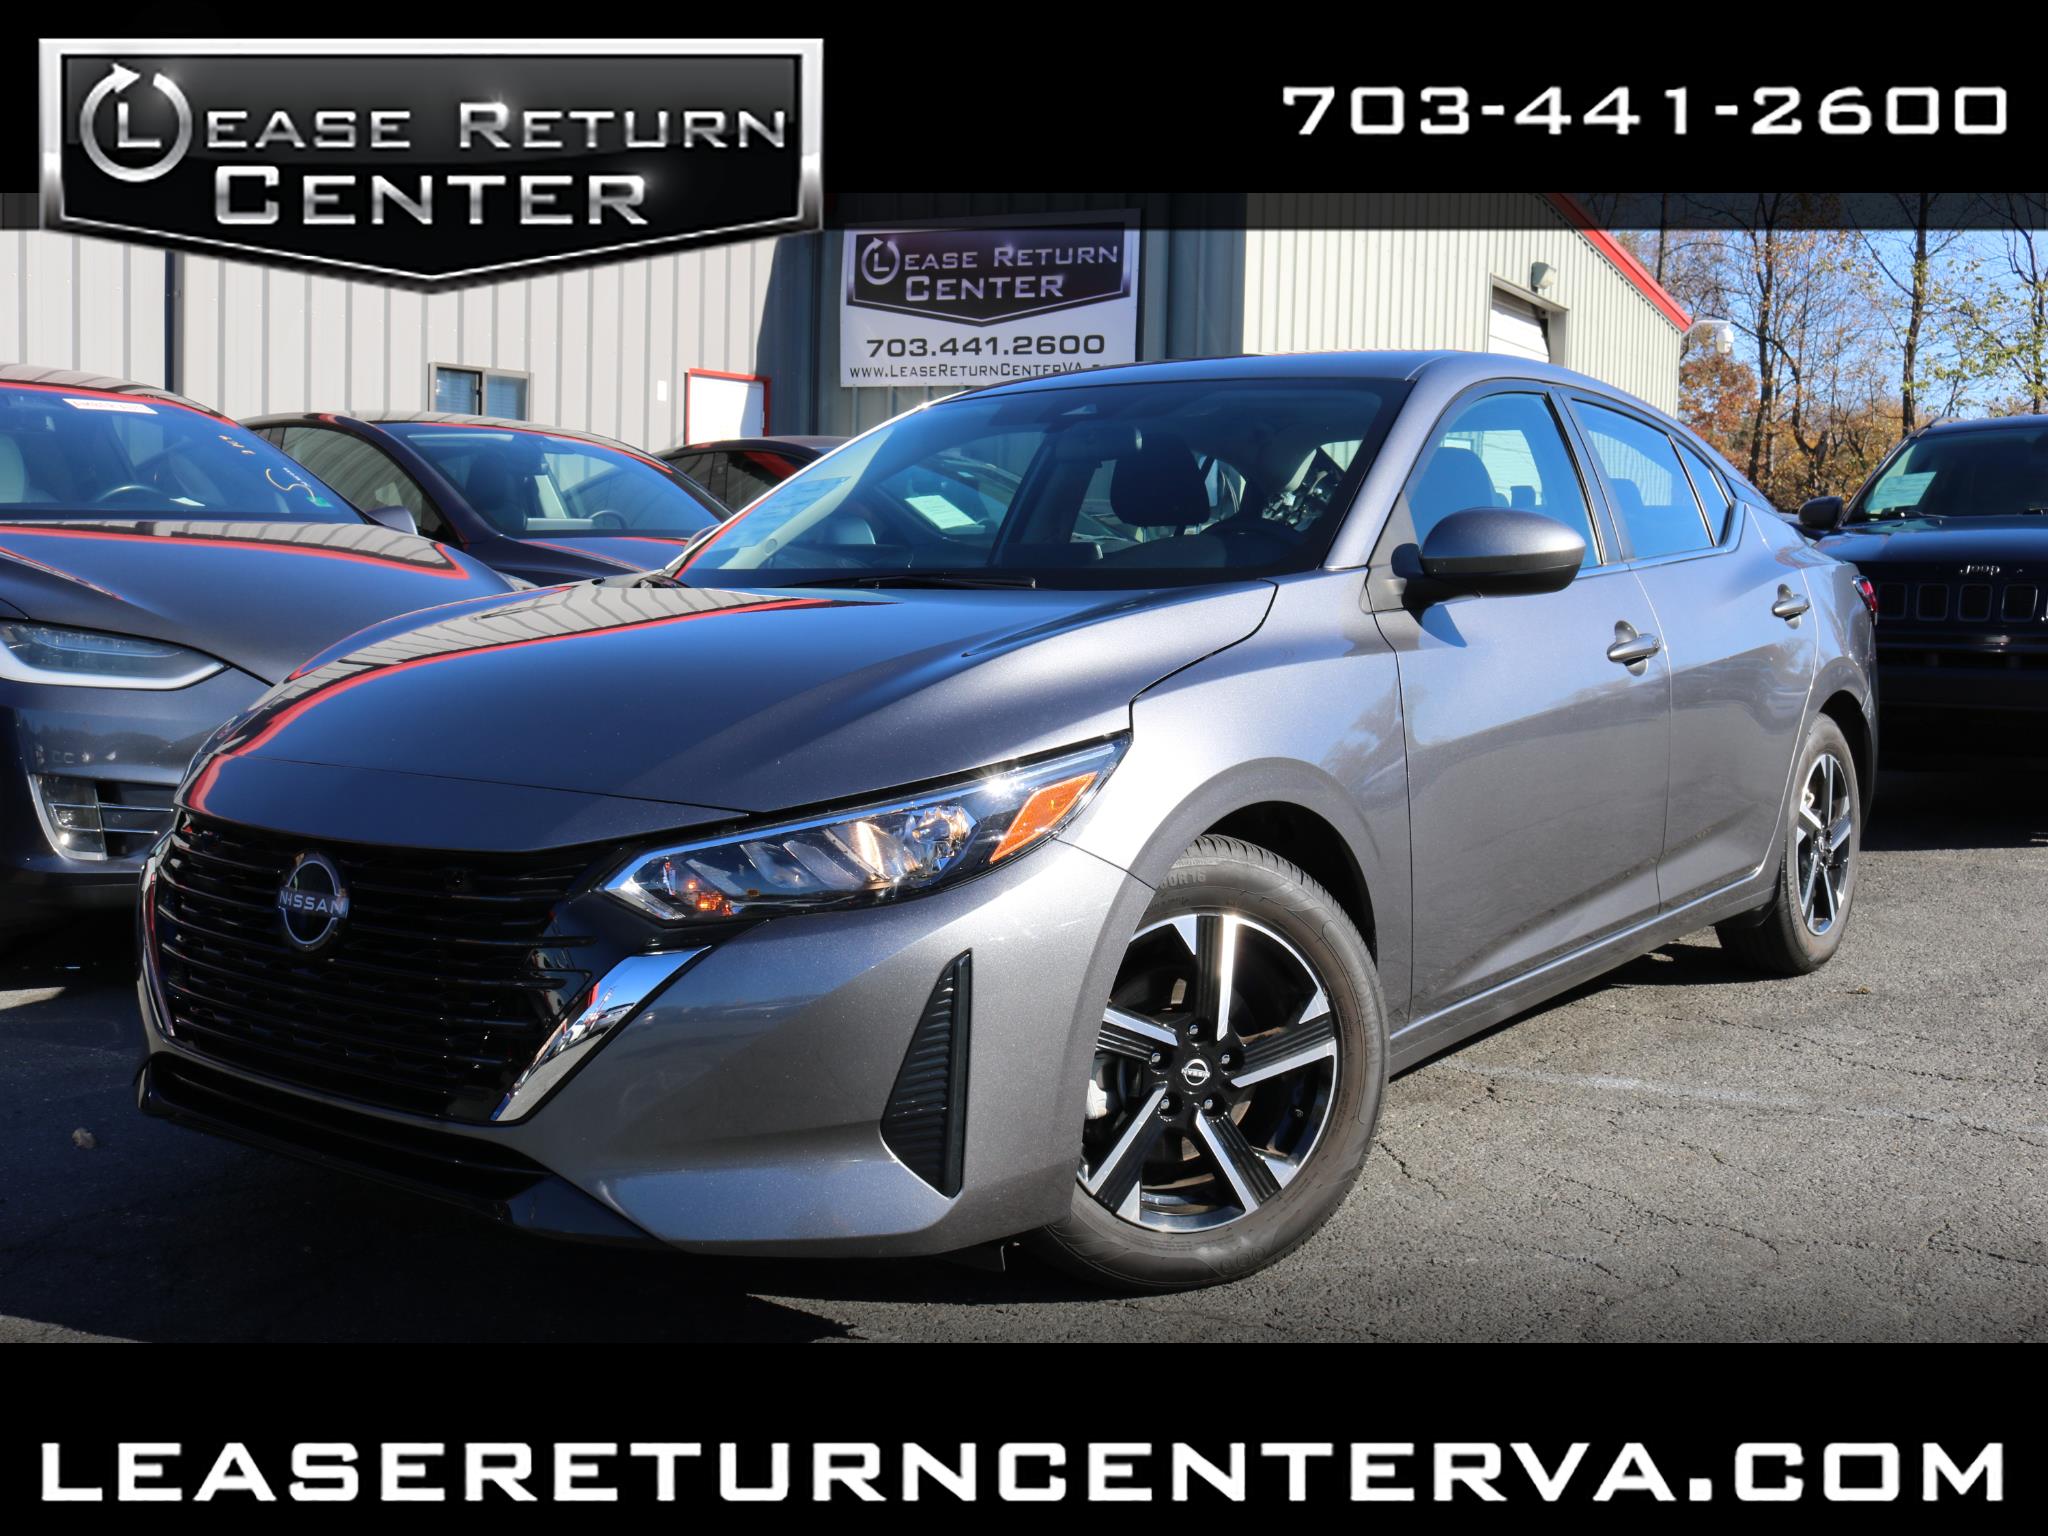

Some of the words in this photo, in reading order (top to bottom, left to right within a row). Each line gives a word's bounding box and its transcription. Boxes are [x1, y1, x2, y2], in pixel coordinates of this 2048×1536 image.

[873, 252, 978, 272] LEASE
[993, 246, 1118, 268] RETURN
[905, 274, 1064, 301] CENTER
[866, 334, 1105, 358] 703.441.2600
[279, 890, 347, 915] NISSAN
